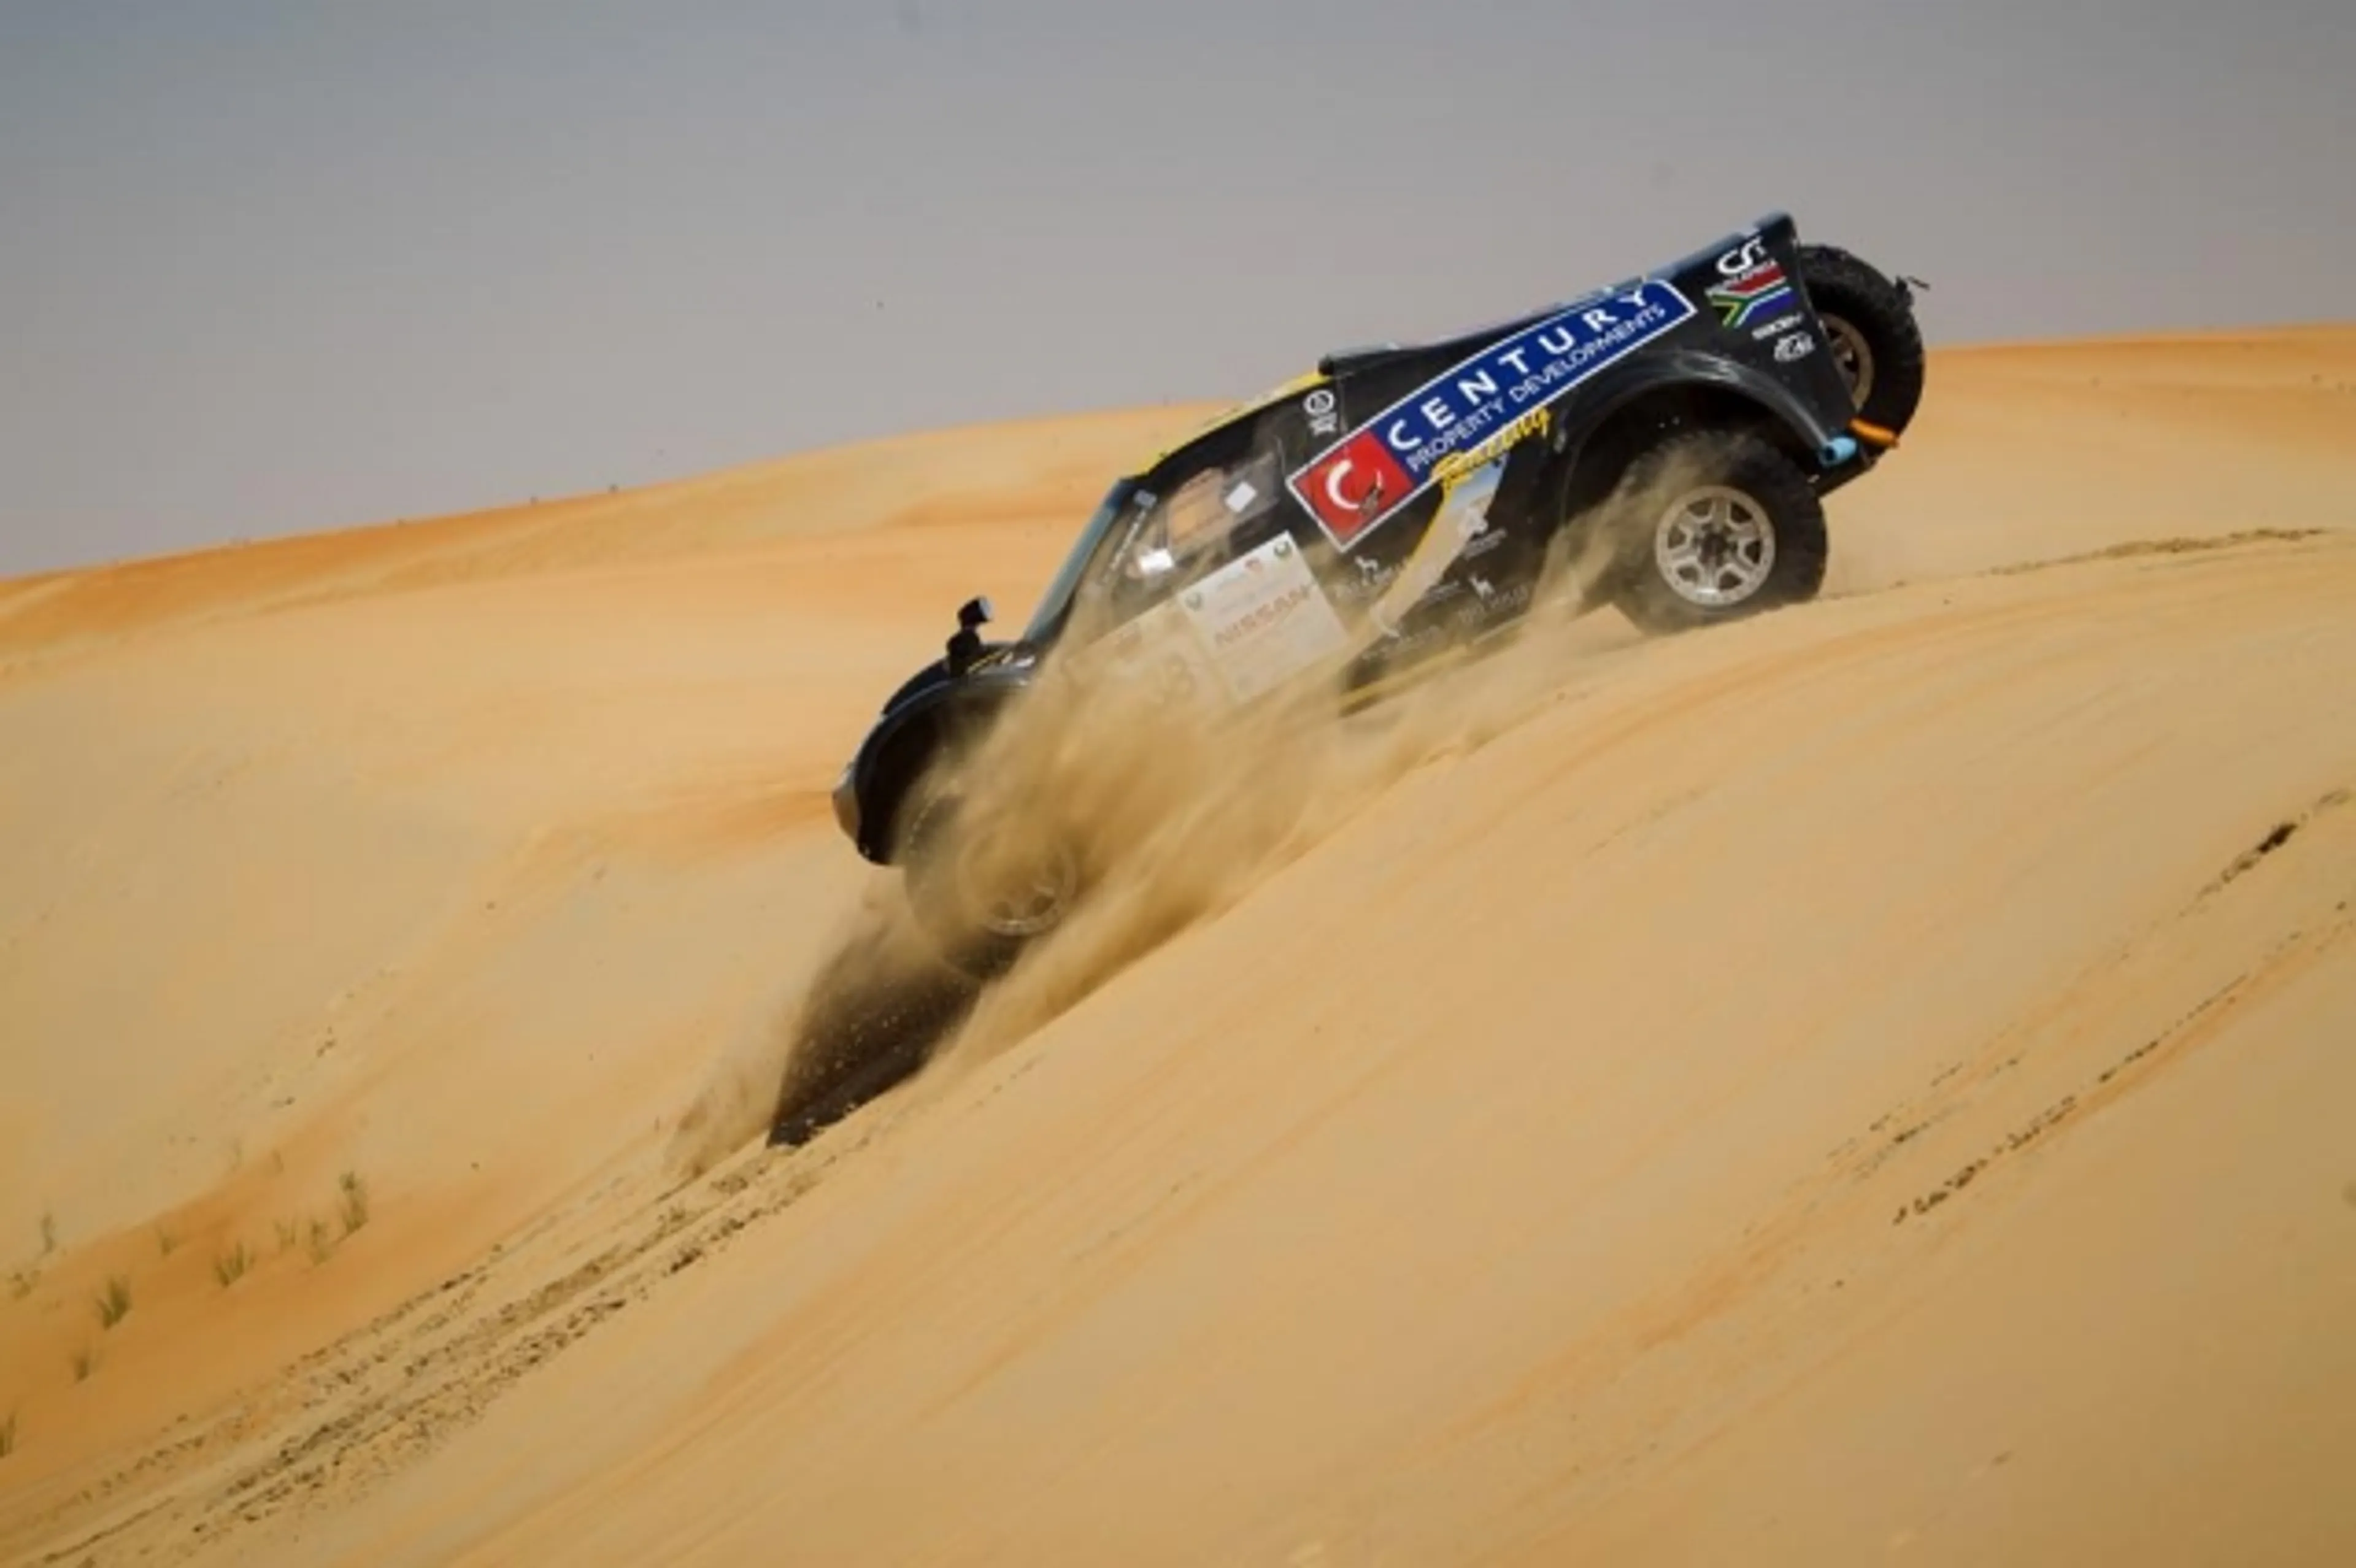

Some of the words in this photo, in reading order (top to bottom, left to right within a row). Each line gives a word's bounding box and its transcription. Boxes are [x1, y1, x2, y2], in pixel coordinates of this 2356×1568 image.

[1387, 289, 1646, 450] CENTURY
[1405, 397, 1506, 472] PROPERTY
[1509, 301, 1666, 402] DEVELOPMENTS
